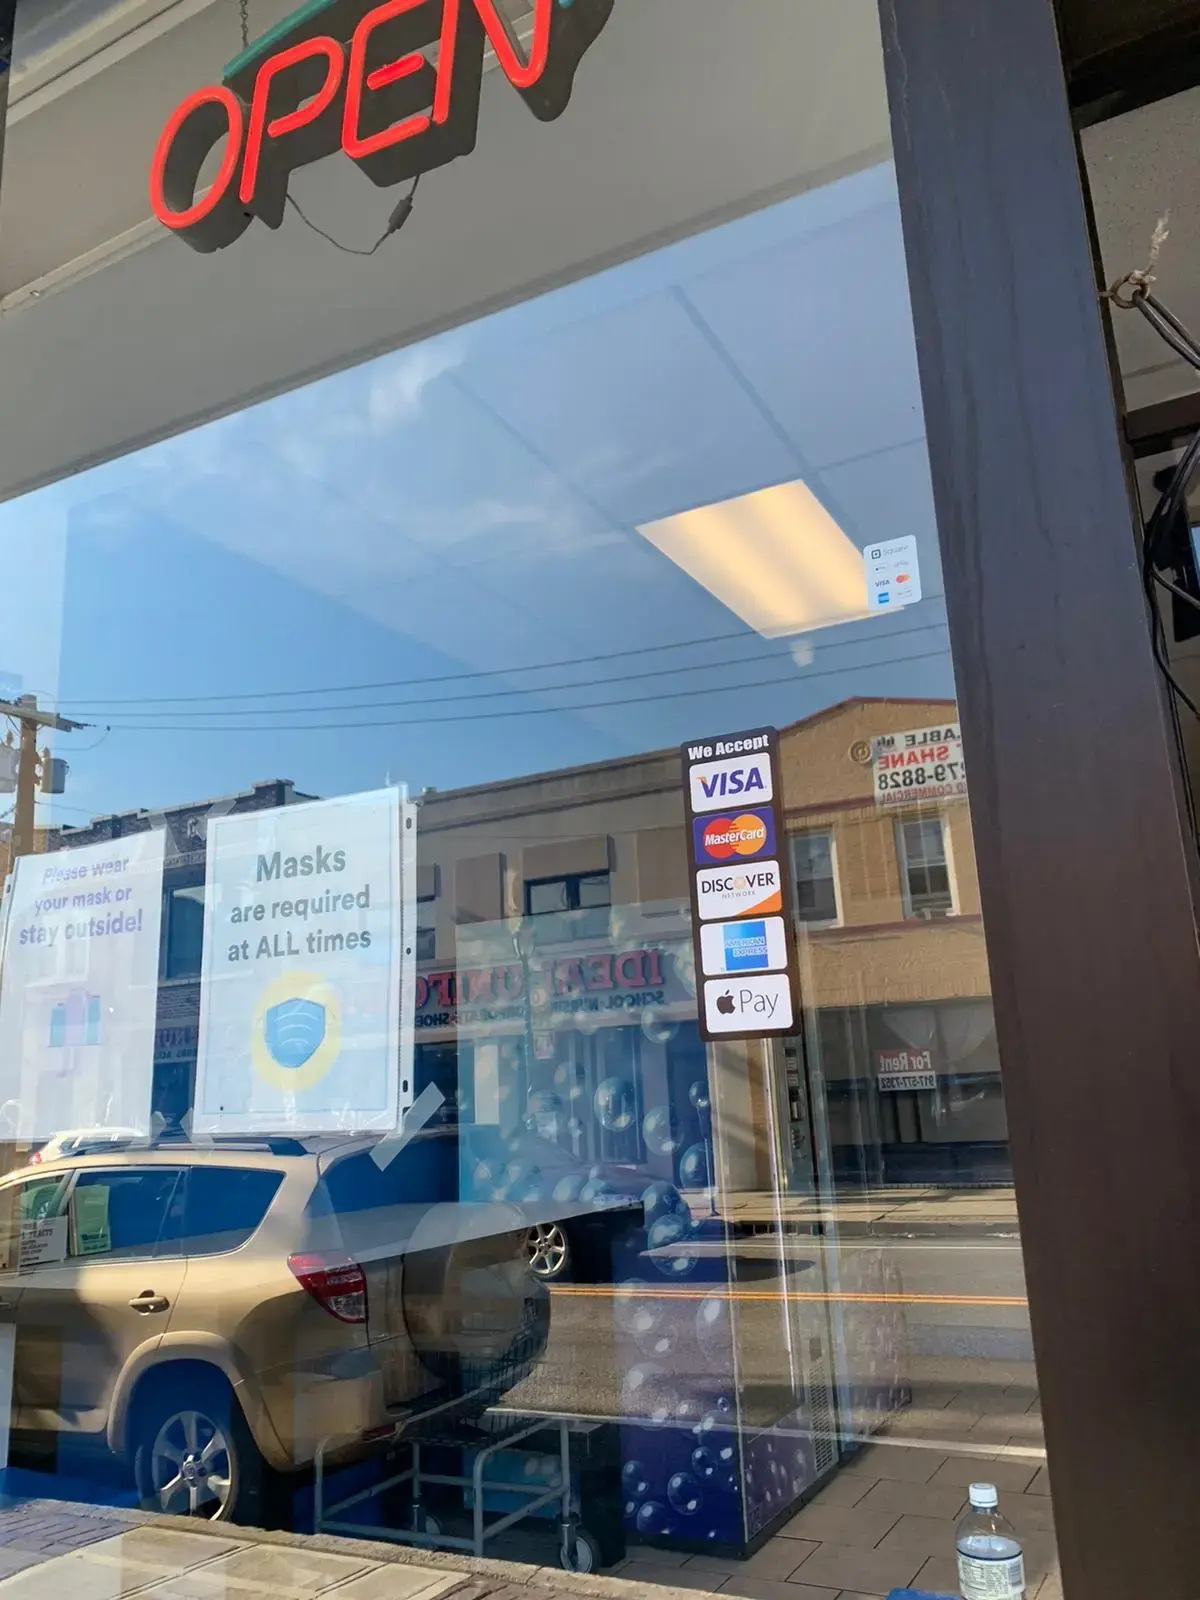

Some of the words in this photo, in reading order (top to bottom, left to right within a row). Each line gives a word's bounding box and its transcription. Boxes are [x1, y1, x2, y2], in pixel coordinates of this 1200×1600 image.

[149, 0, 553, 229] OPEN
[874, 579, 890, 587] VISA
[688, 746, 713, 760] We
[715, 734, 769, 755] Accept
[696, 767, 764, 799] VISA
[704, 828, 765, 846] MasterCard
[42, 864, 88, 885] Please
[91, 858, 130, 877] wear
[256, 845, 346, 882] Masks
[701, 872, 775, 894] DISCOVER
[721, 889, 757, 900] NETWORK
[34, 895, 68, 917] your
[72, 885, 111, 907] mask
[115, 887, 132, 901] or
[230, 904, 266, 924] are
[271, 883, 370, 921] required
[19, 924, 59, 947] stay
[64, 908, 144, 940] outside!
[724, 936, 766, 947] AMERICAN
[228, 939, 249, 962] at
[255, 934, 300, 960] ALL
[306, 928, 372, 954] times
[733, 945, 768, 957] EXPRESS
[740, 989, 779, 1019] Pay
